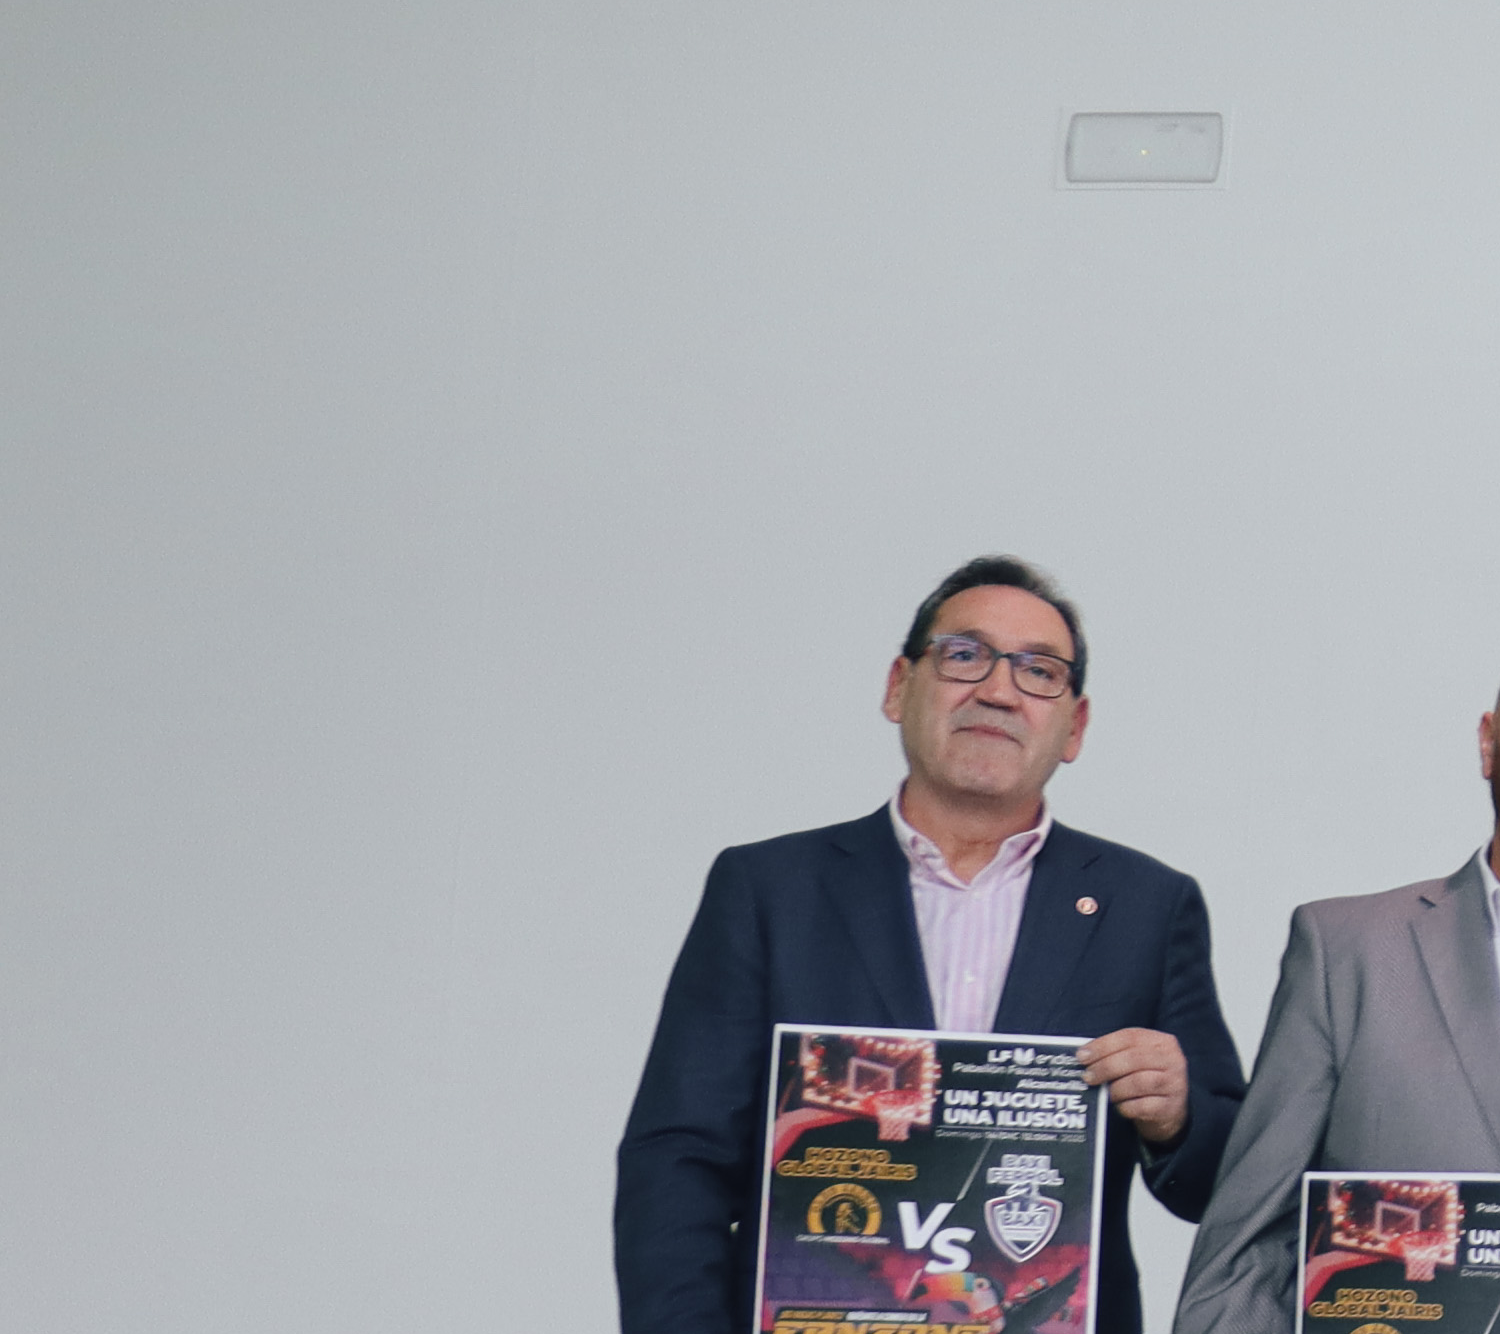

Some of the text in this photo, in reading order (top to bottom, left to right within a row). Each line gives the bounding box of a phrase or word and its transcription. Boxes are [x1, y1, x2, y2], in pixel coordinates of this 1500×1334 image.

[945, 1089, 978, 1106] UN
[945, 1107, 1084, 1129] UNA ILUSIÓN
[1468, 1229, 1500, 1246] UN
